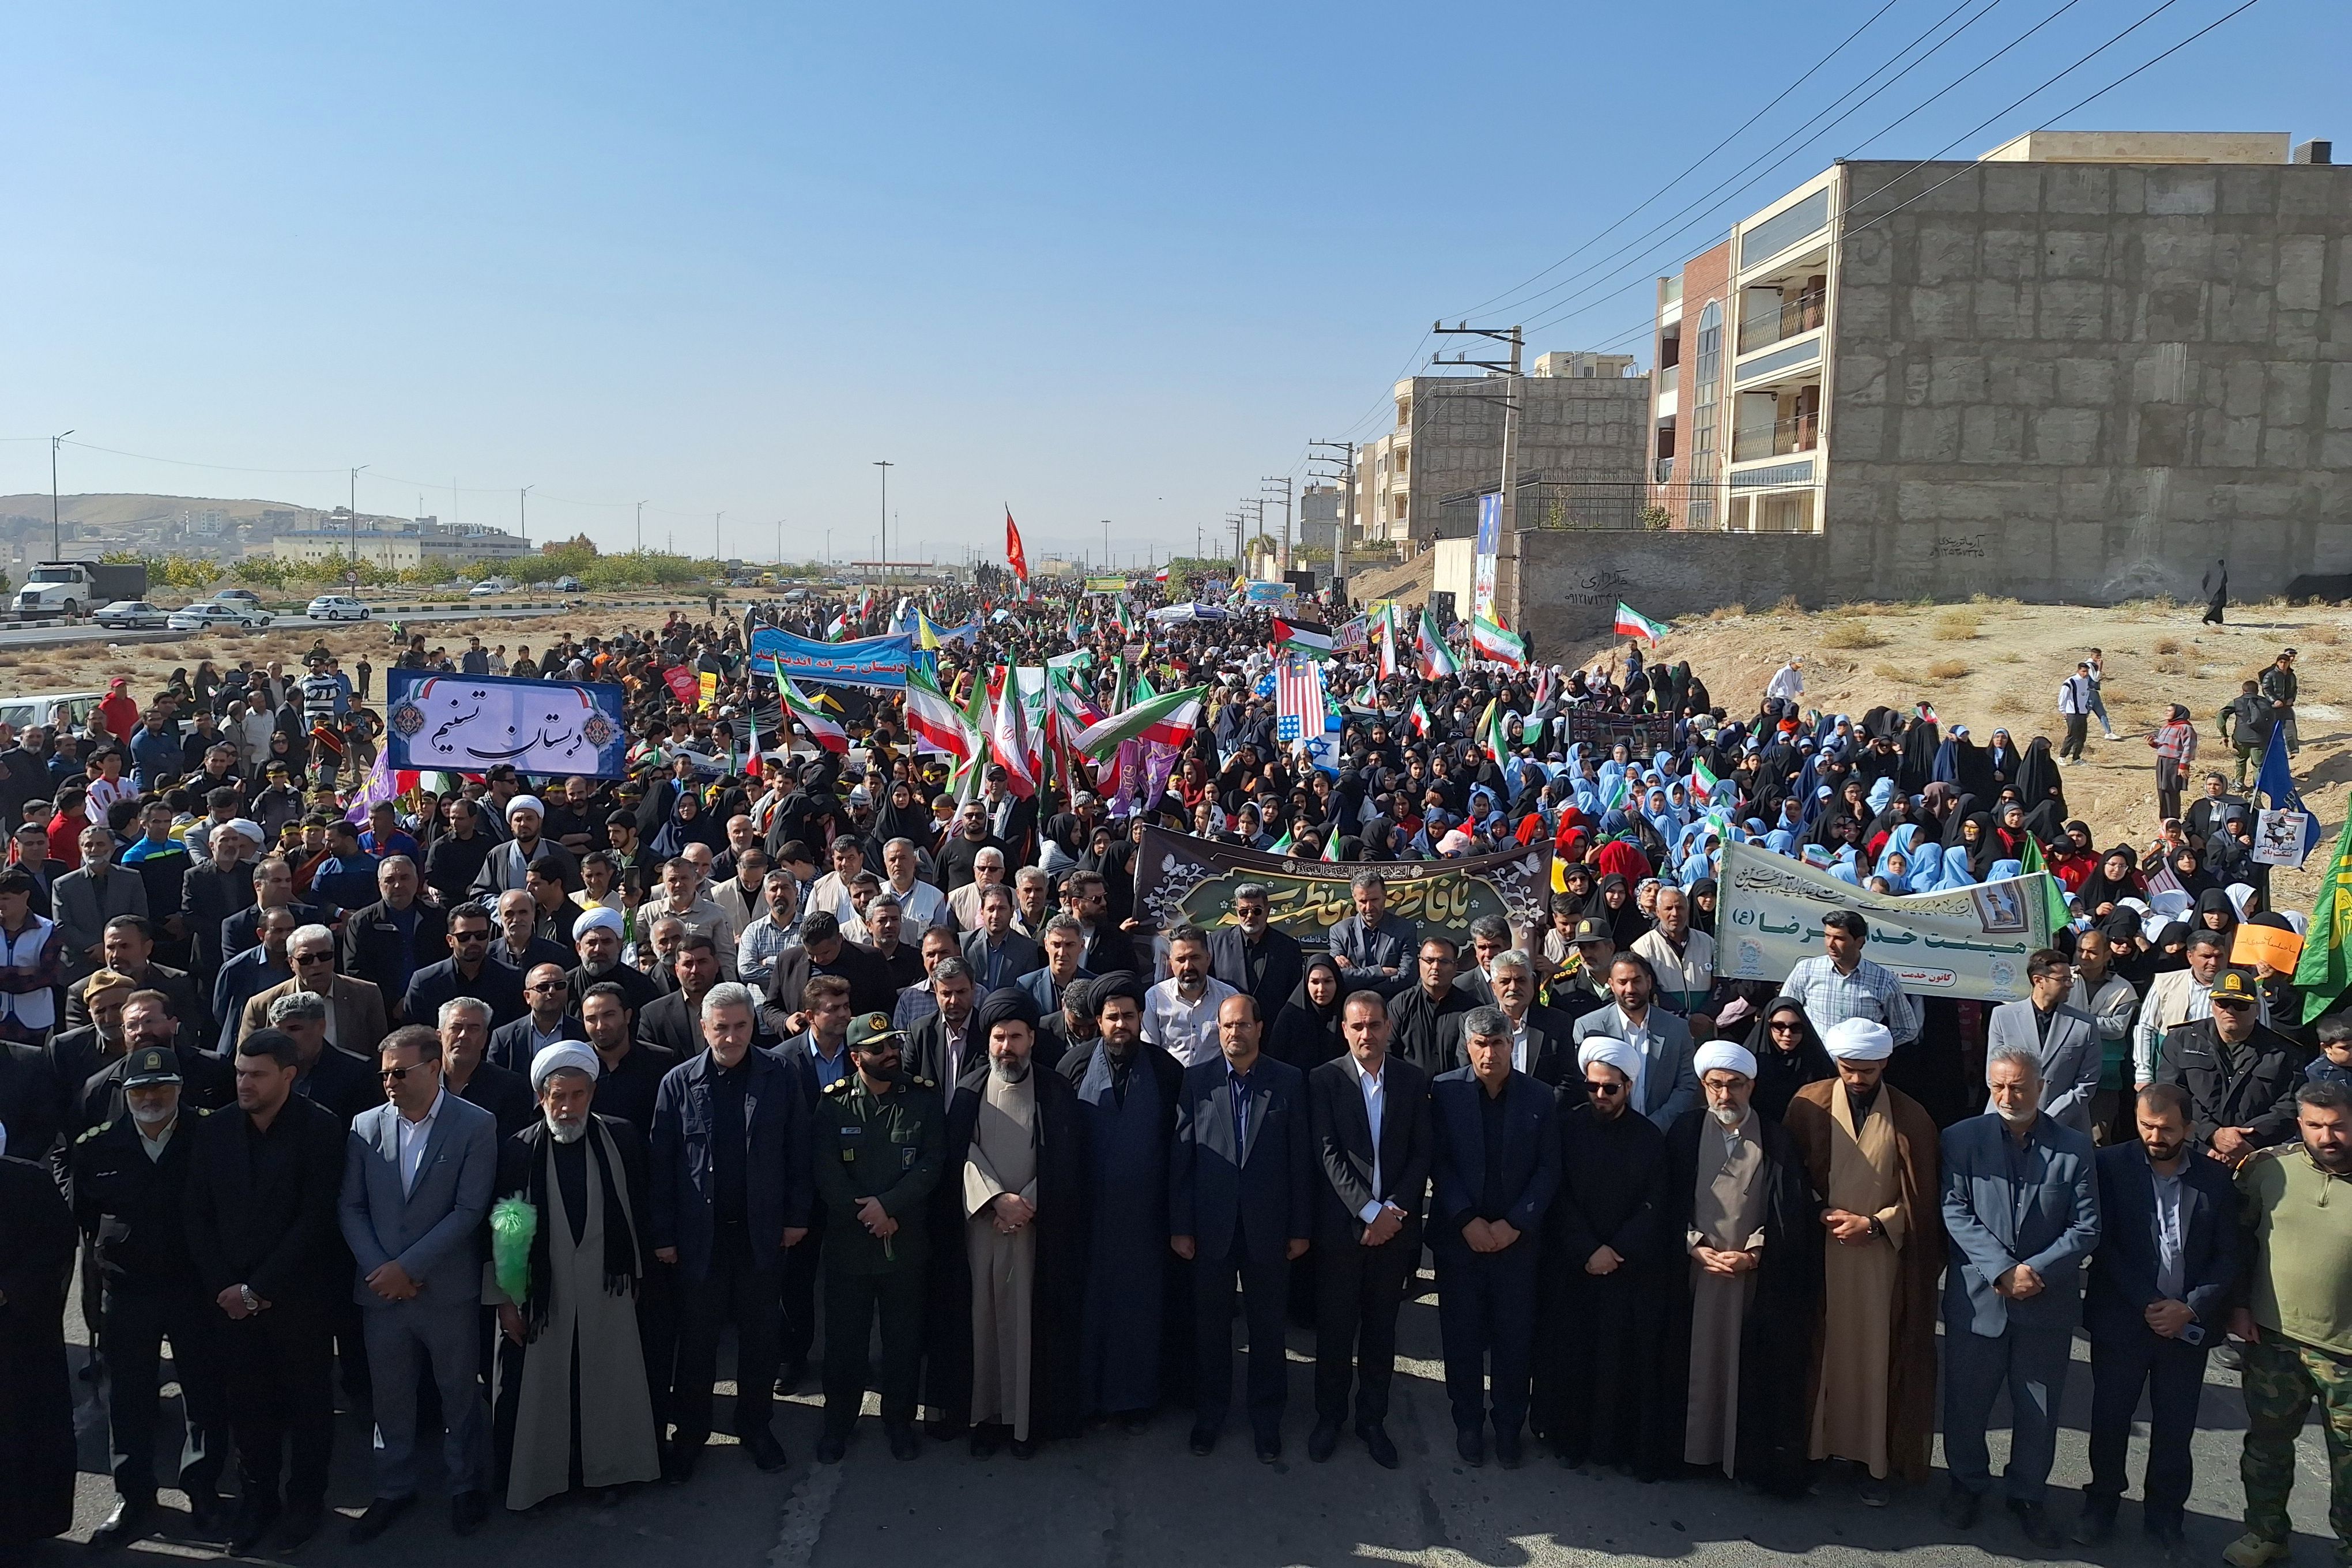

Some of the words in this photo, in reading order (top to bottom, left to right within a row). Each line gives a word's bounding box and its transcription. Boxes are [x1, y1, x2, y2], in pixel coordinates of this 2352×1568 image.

[755, 647, 812, 667] اندیشمند
[860, 659, 906, 676] دبستان
[431, 690, 488, 753] تسنیم
[466, 713, 582, 759] دبستان
[1732, 907, 1755, 925] (ع)
[1901, 971, 1927, 979] خدمت
[1928, 973, 1952, 983] کانون
